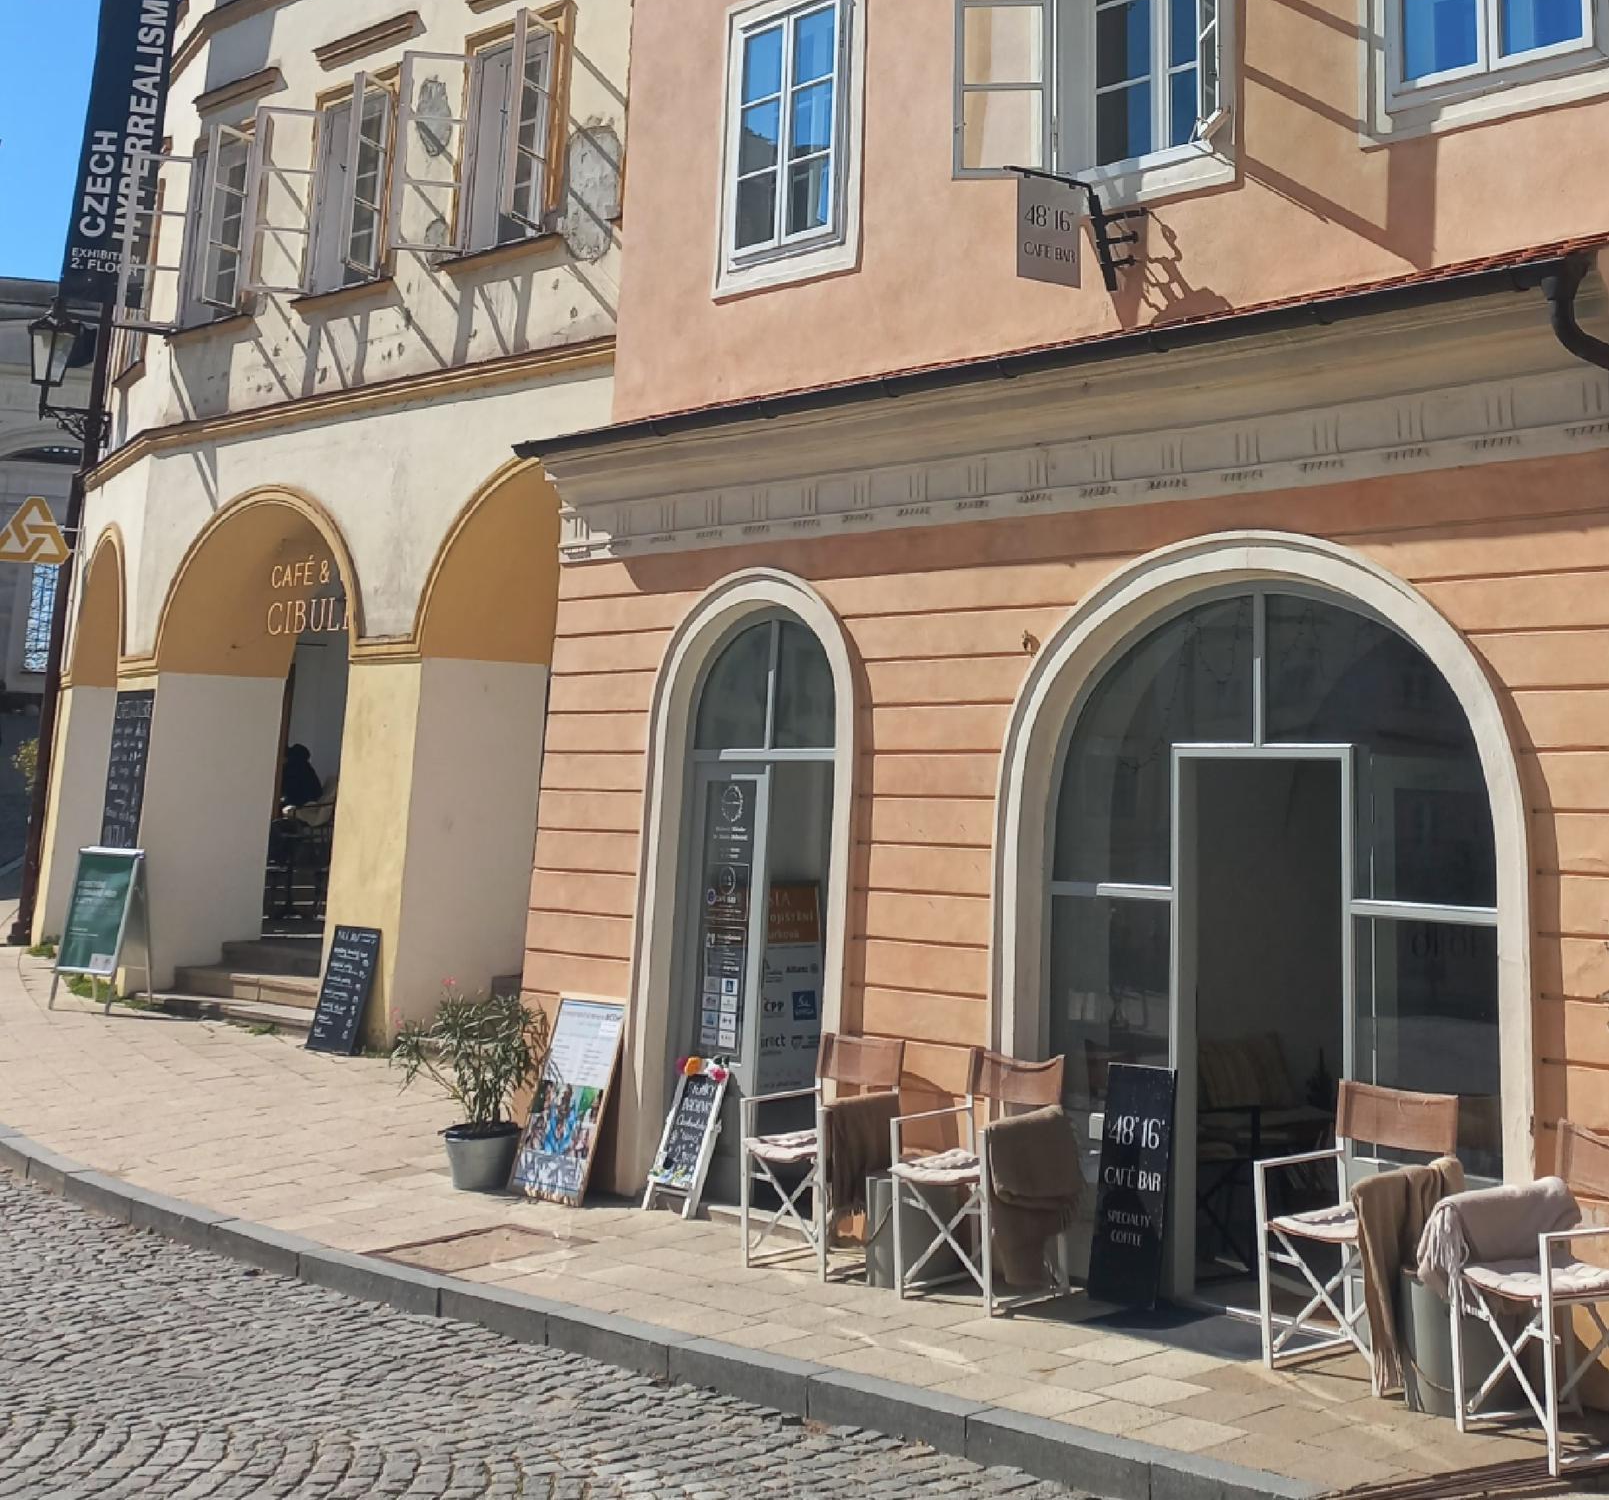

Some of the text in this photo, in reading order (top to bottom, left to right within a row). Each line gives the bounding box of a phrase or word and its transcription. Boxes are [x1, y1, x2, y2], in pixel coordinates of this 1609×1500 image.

[111, 0, 170, 243] HYPERREALISM
[79, 130, 118, 238] CZECH
[71, 247, 140, 264] EXHIBITIN
[1055, 247, 1076, 263] BAR
[271, 554, 330, 589] CAFÉ &
[1104, 1165, 1161, 1192] CAFÉ BAR
[1107, 1209, 1152, 1229] SPECIALTY
